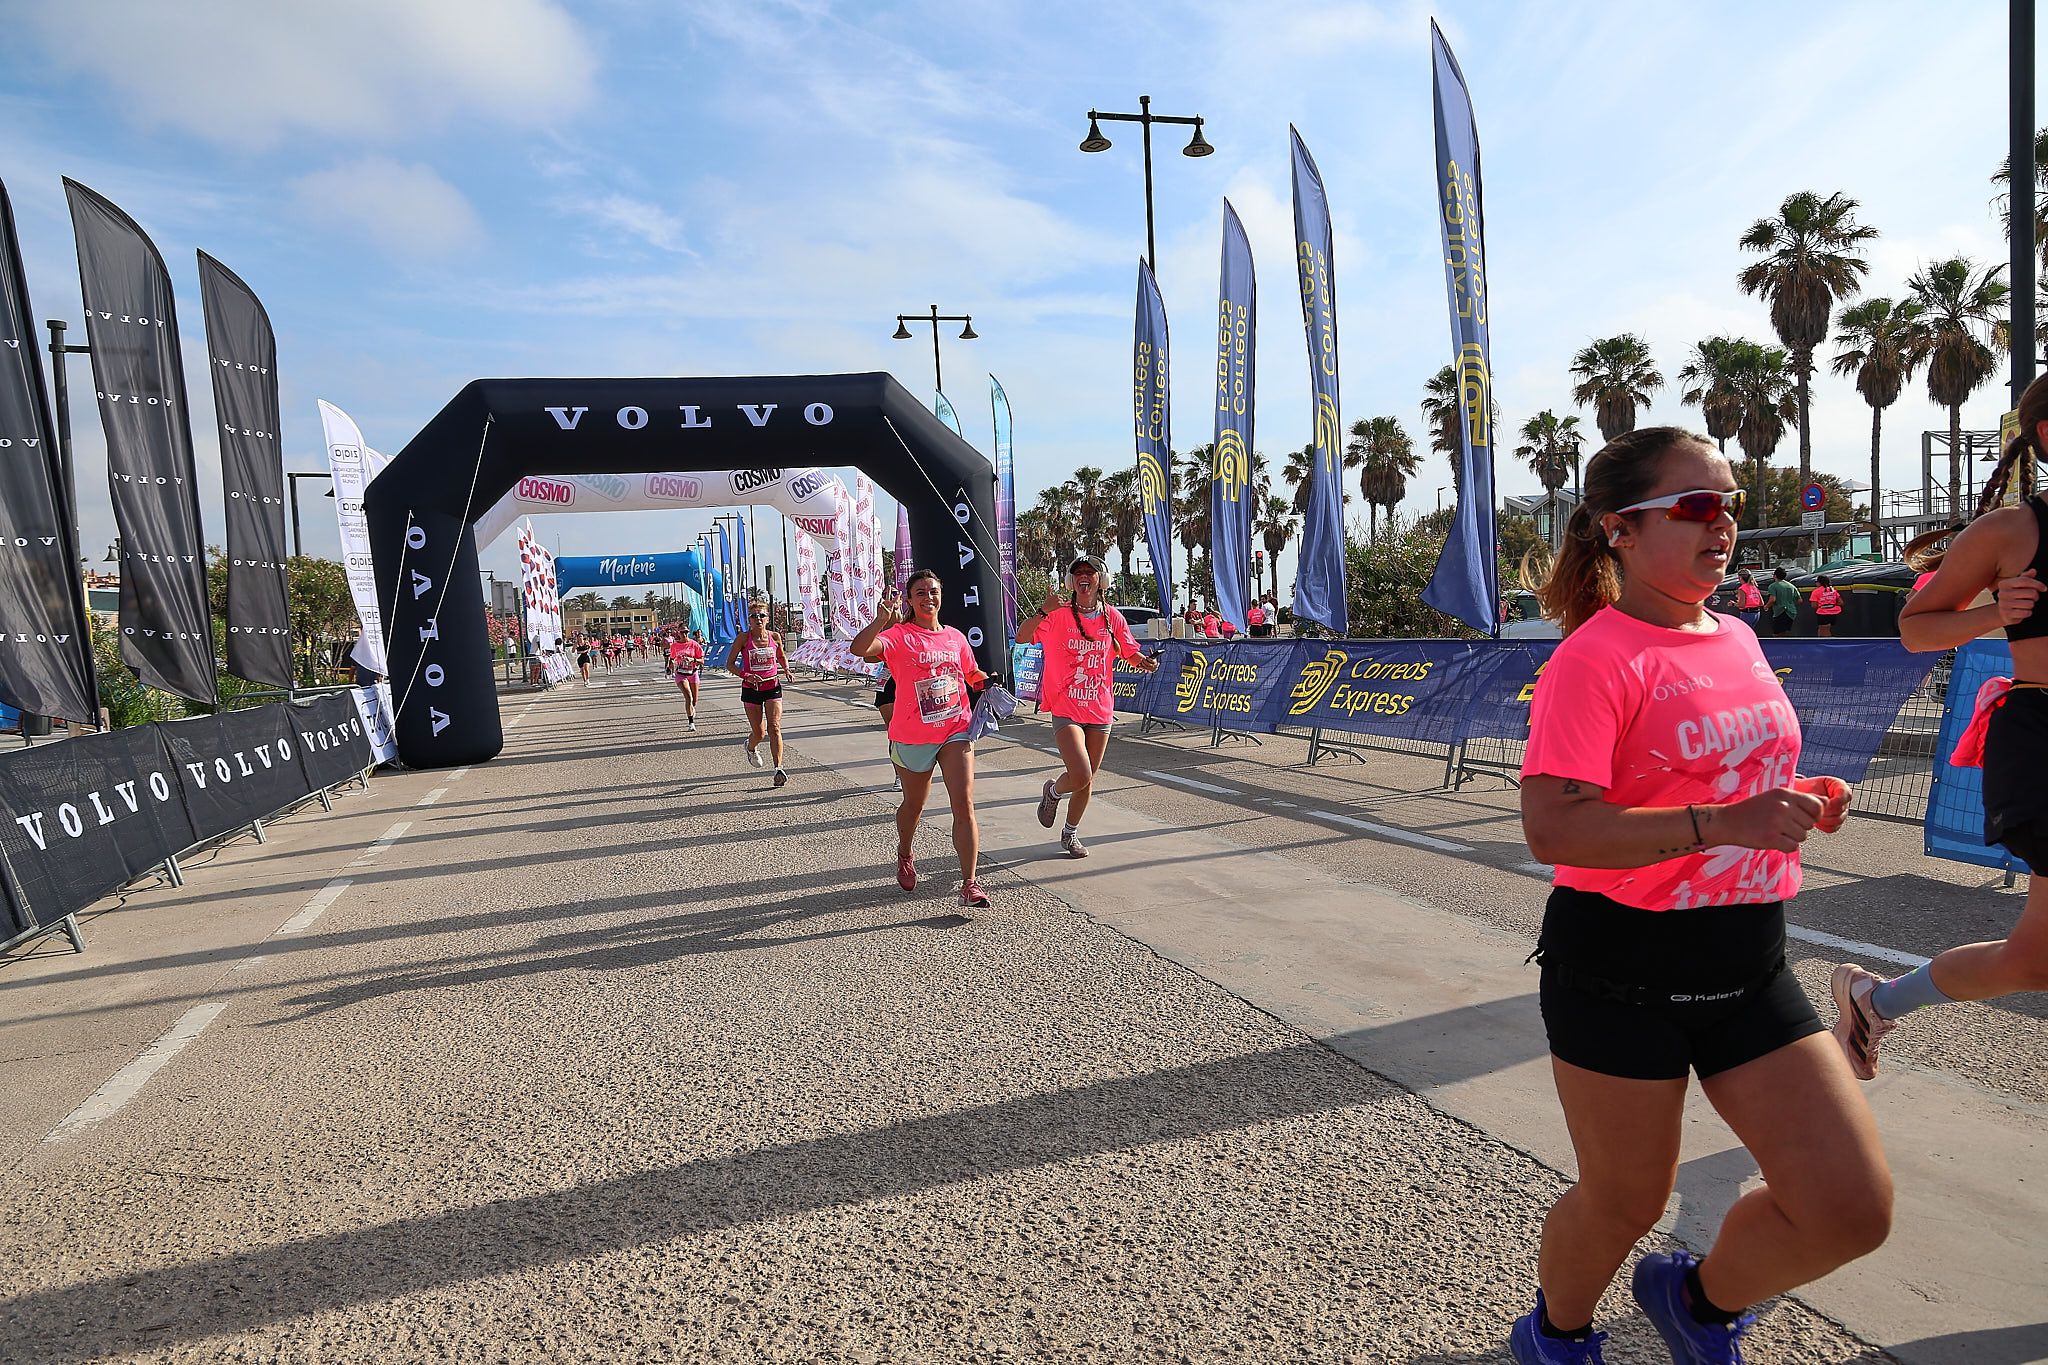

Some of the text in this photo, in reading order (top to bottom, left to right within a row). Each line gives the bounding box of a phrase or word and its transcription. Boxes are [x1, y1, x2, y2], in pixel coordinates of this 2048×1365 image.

[544, 402, 834, 430] VOLVO
[519, 478, 570, 503] COSMO
[649, 476, 698, 498] COSMO
[734, 468, 781, 492] COSMO
[599, 557, 656, 582] Marlene
[954, 503, 984, 648] OLVO
[408, 526, 450, 737] VOLVO
[1068, 639, 1107, 650] CARRERA
[1211, 658, 1258, 682] Correos
[1351, 657, 1434, 680] Correos
[934, 694, 951, 705] 016
[1068, 690, 1098, 701] MUJER
[1203, 686, 1251, 715] Express
[1330, 684, 1415, 717] Express
[1653, 674, 1714, 701] OYSHO
[301, 716, 361, 753] VOLVO
[186, 738, 292, 789] VOLVO
[16, 771, 170, 851] VOLVO
